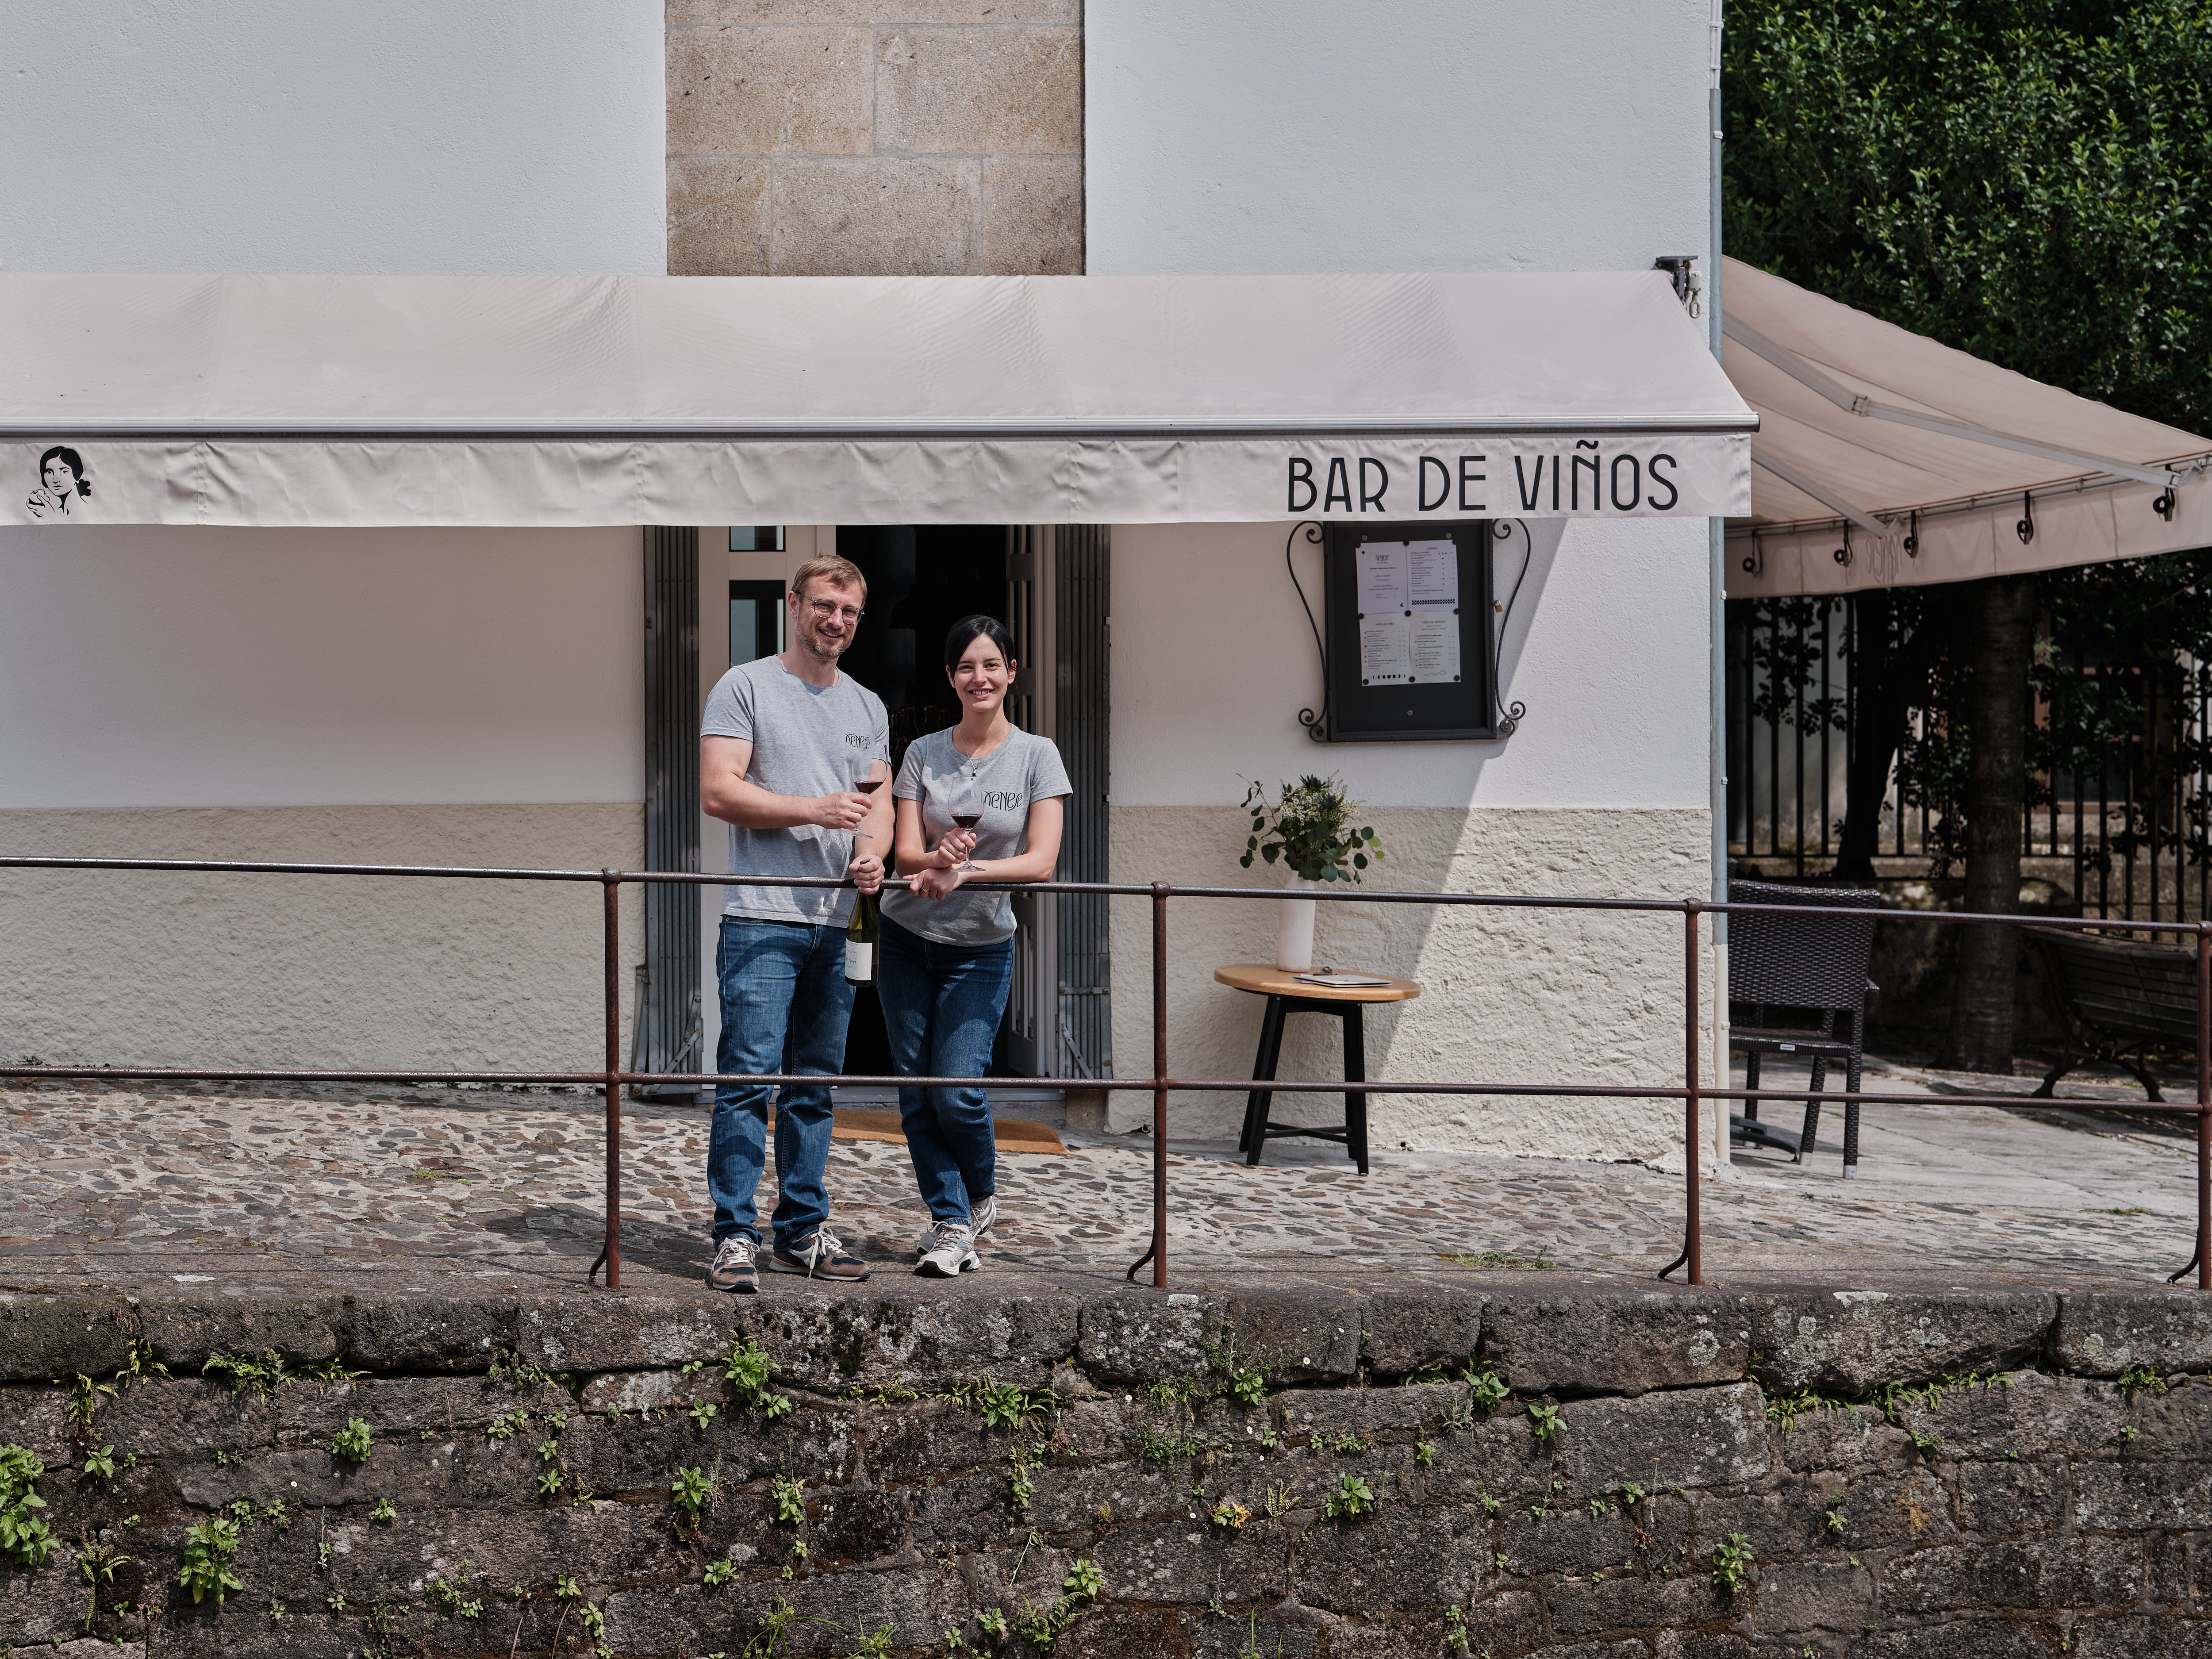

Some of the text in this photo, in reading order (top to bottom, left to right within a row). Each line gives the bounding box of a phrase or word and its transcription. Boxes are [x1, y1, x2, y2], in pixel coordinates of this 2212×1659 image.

[1288, 440, 1678, 512] BAR DE VIÑOS
